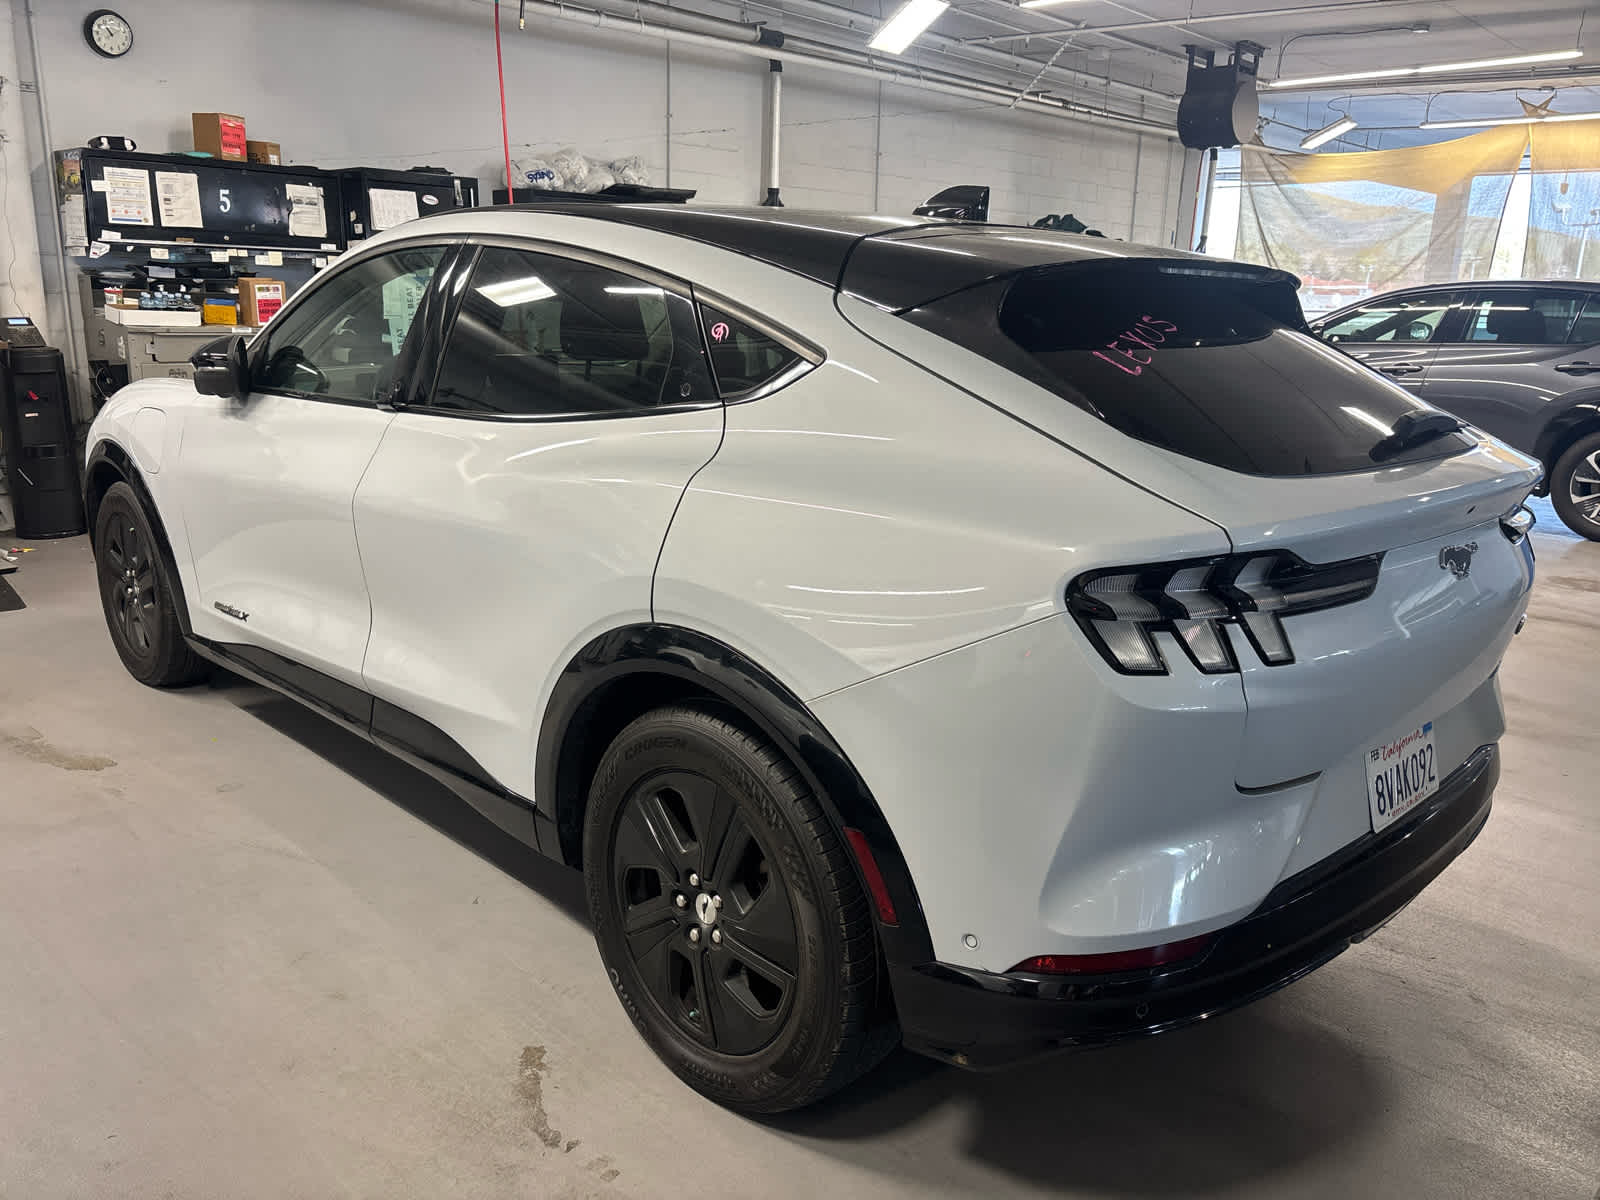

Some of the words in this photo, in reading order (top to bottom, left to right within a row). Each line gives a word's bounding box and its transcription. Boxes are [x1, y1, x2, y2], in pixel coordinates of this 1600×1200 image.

[219, 189, 231, 213] 5
[1091, 315, 1178, 377] LEXUS
[1381, 729, 1424, 761] California
[1375, 743, 1436, 817] 8VAK092
